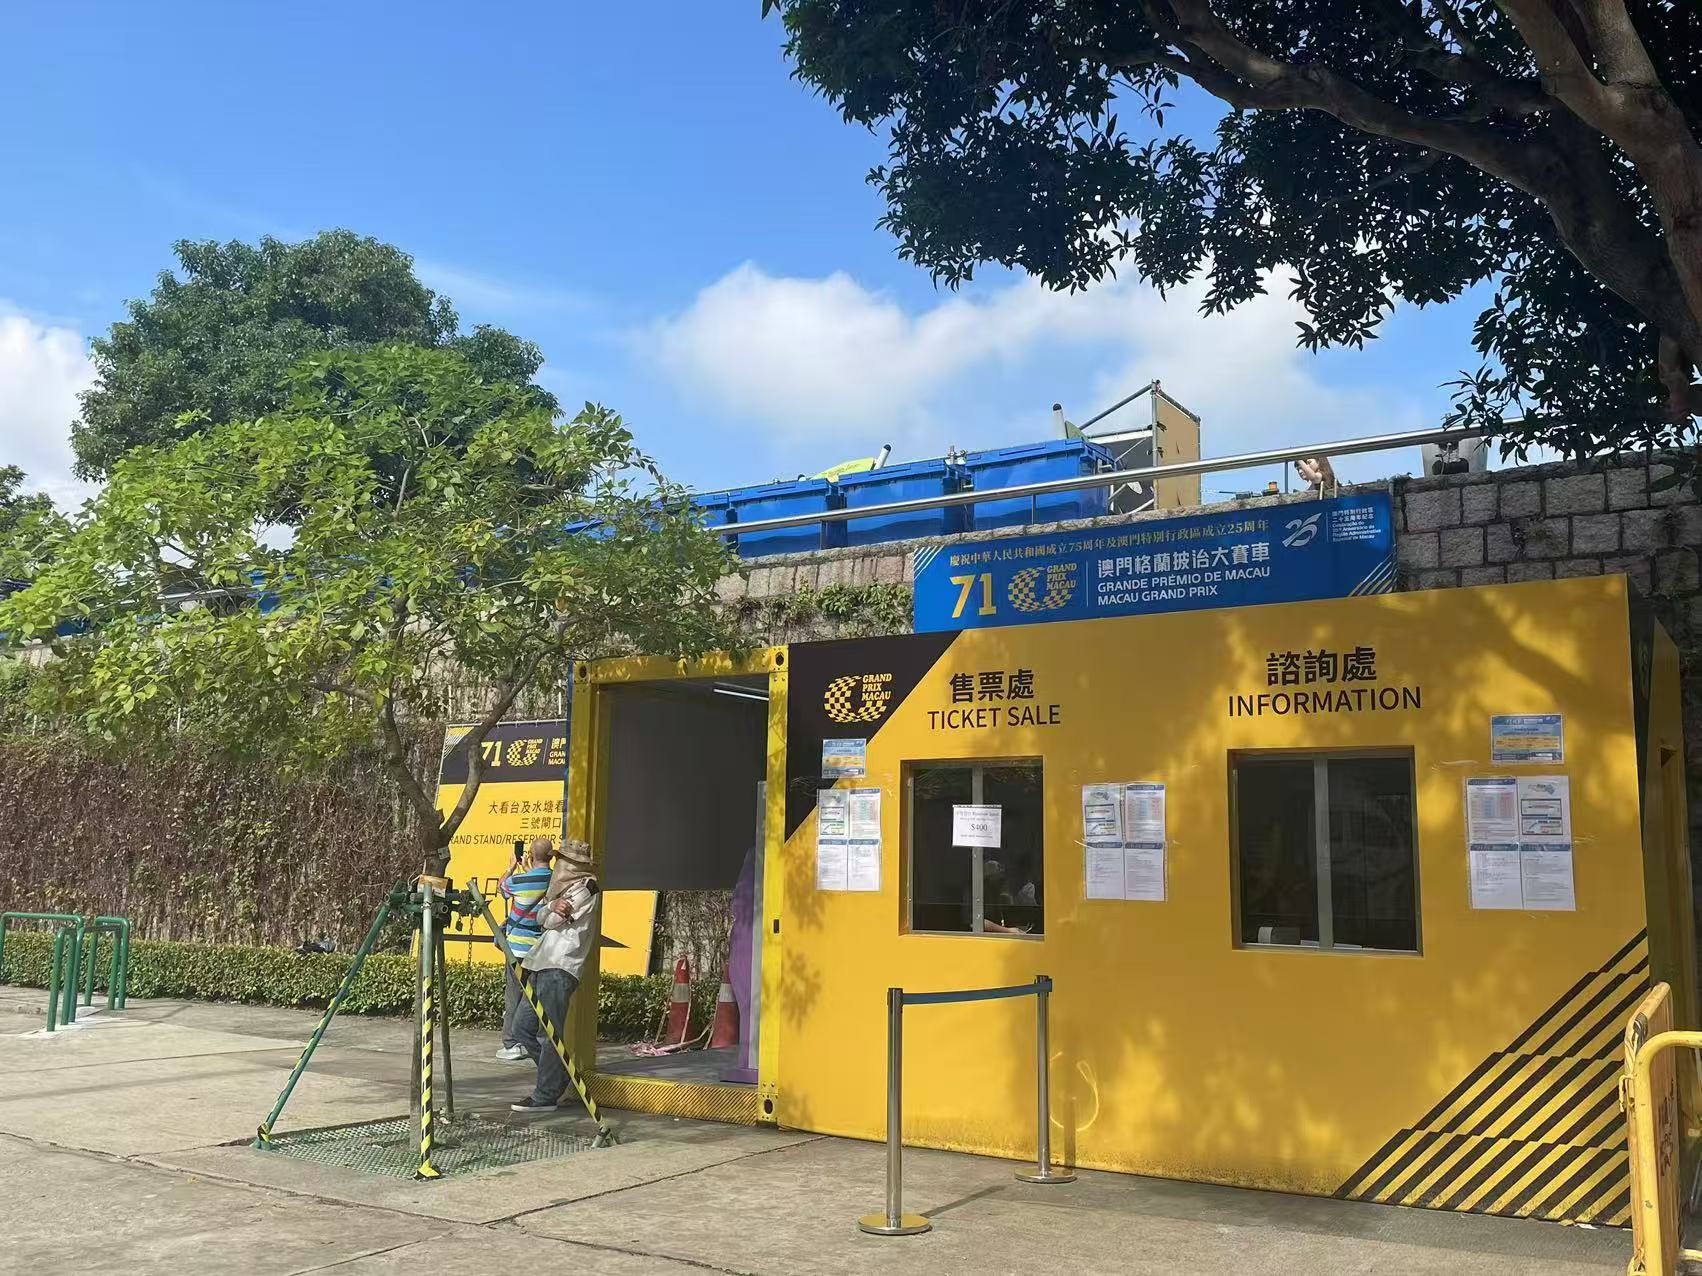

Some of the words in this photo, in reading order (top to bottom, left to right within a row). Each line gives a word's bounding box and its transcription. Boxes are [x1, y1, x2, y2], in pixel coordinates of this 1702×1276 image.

[1047, 562, 1077, 574] GRAND
[1097, 542, 1270, 578] 澳門格蘭披治大賽車
[1047, 572, 1066, 582] PRIX
[1047, 580, 1077, 591] MACAU
[1097, 579, 1149, 593] GRANDE
[1151, 573, 1201, 588] PRÉMIO
[1204, 570, 1222, 582] DE
[1225, 566, 1270, 581] MACAU
[950, 573, 997, 618] 71
[1098, 592, 1139, 606] MACAU
[1141, 587, 1186, 601] GRAND
[1189, 584, 1218, 597] PRIX
[862, 673, 892, 683] GRAND
[1266, 646, 1377, 686] 諮詢處
[862, 682, 882, 692] PRIX
[862, 691, 892, 701] MACAU
[949, 669, 1034, 703] 售票處
[1228, 686, 1421, 717] INFORMATION
[927, 707, 1001, 729] TICKET
[1007, 704, 1061, 727] SALE
[481, 741, 502, 767] 71
